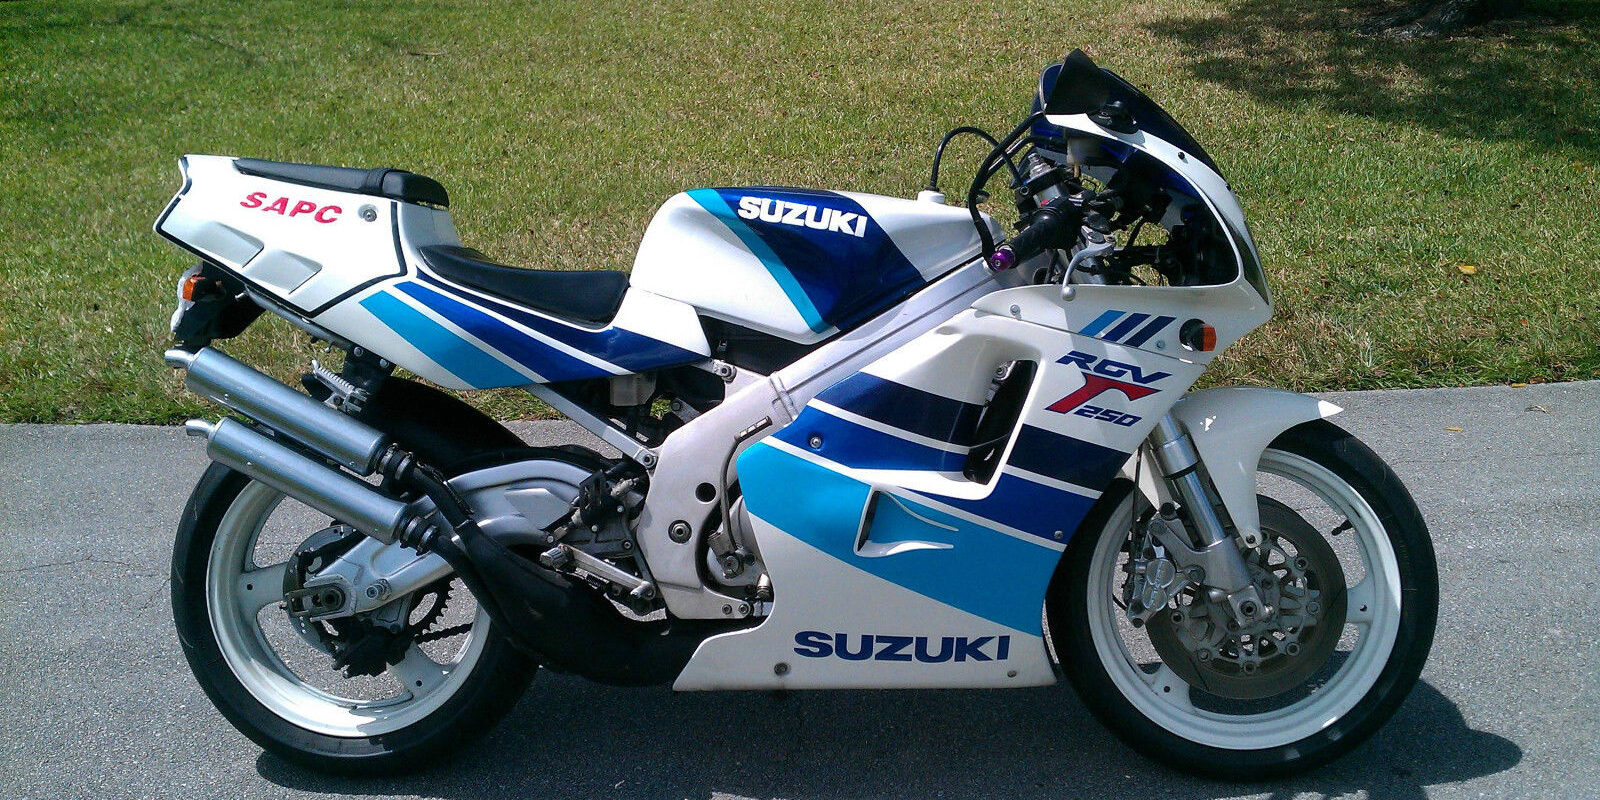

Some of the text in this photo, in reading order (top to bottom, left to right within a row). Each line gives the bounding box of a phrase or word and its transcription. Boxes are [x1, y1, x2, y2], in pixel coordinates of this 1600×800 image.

[240, 191, 342, 224] SAPC
[737, 196, 868, 238] SUZUKI
[1055, 350, 1173, 384] RGV
[1073, 404, 1142, 427] 250
[794, 630, 1010, 663] SUZUKI
